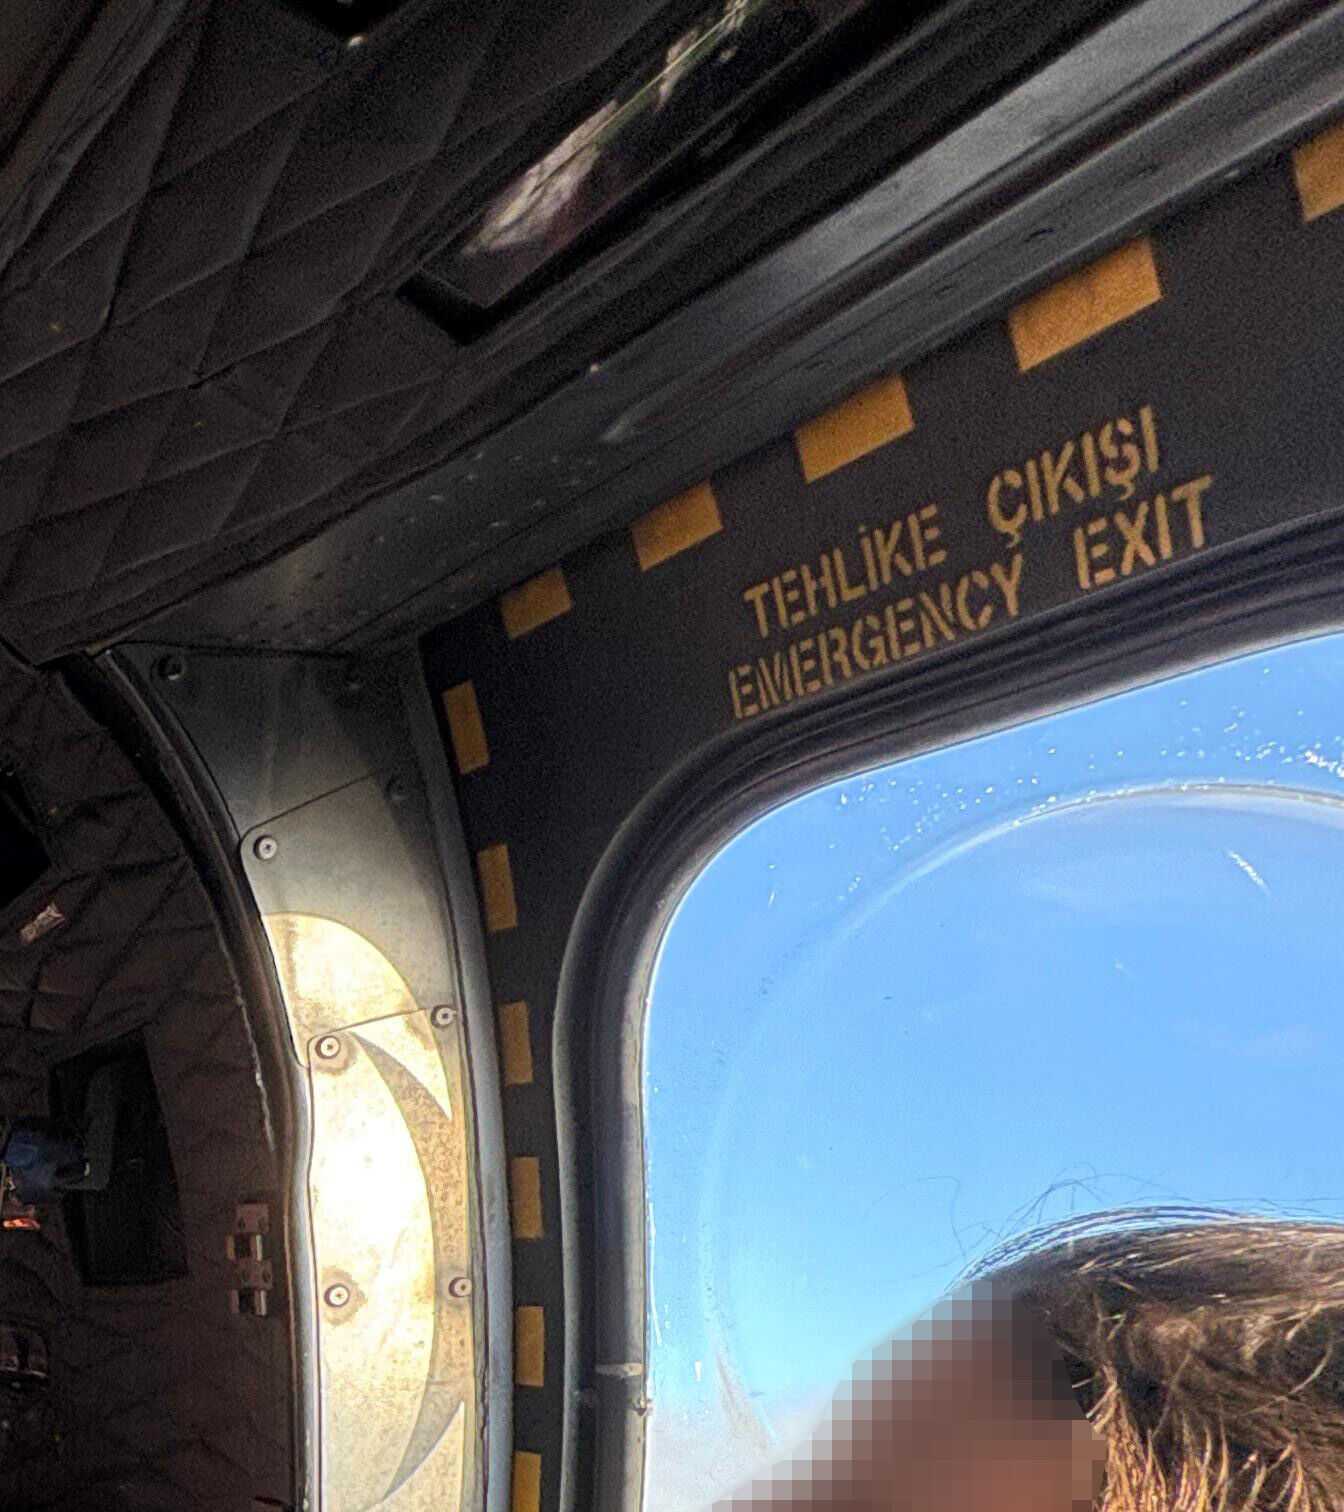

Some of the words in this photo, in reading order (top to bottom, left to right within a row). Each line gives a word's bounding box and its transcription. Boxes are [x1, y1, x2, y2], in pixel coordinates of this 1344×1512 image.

[728, 552, 1026, 720] EMERGENCY
[1074, 475, 1214, 591] EXIT
[743, 503, 948, 639] TEHLİKE
[986, 405, 1160, 548] ÇIKIŞI
